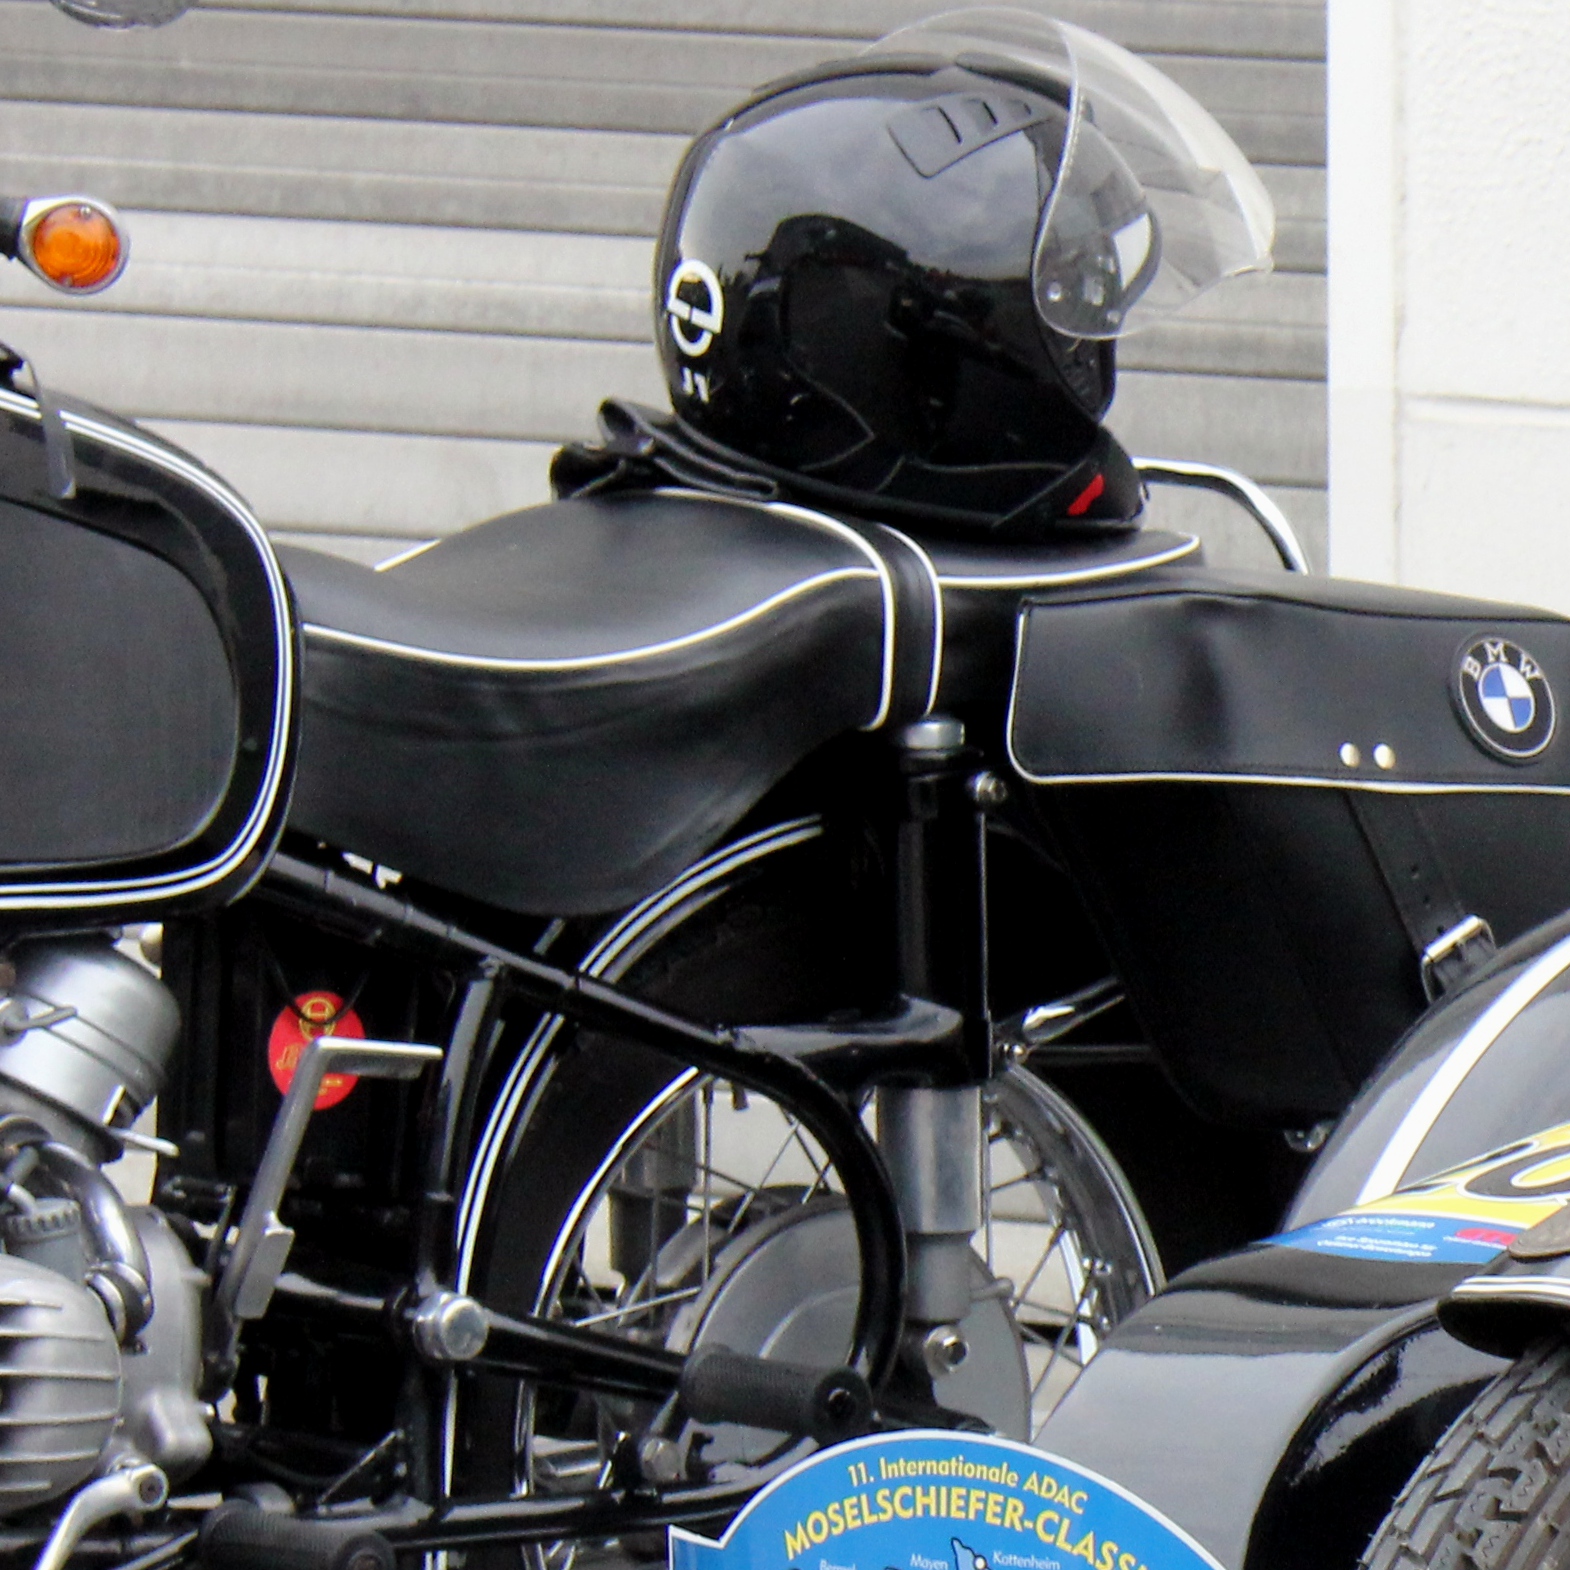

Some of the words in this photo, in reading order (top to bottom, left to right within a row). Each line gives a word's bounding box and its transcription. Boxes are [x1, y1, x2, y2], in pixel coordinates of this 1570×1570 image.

[1463, 641, 1543, 680] BMW
[847, 1464, 875, 1487] 11.
[879, 1455, 1019, 1487] Internationale
[1022, 1471, 1089, 1515] ADAC
